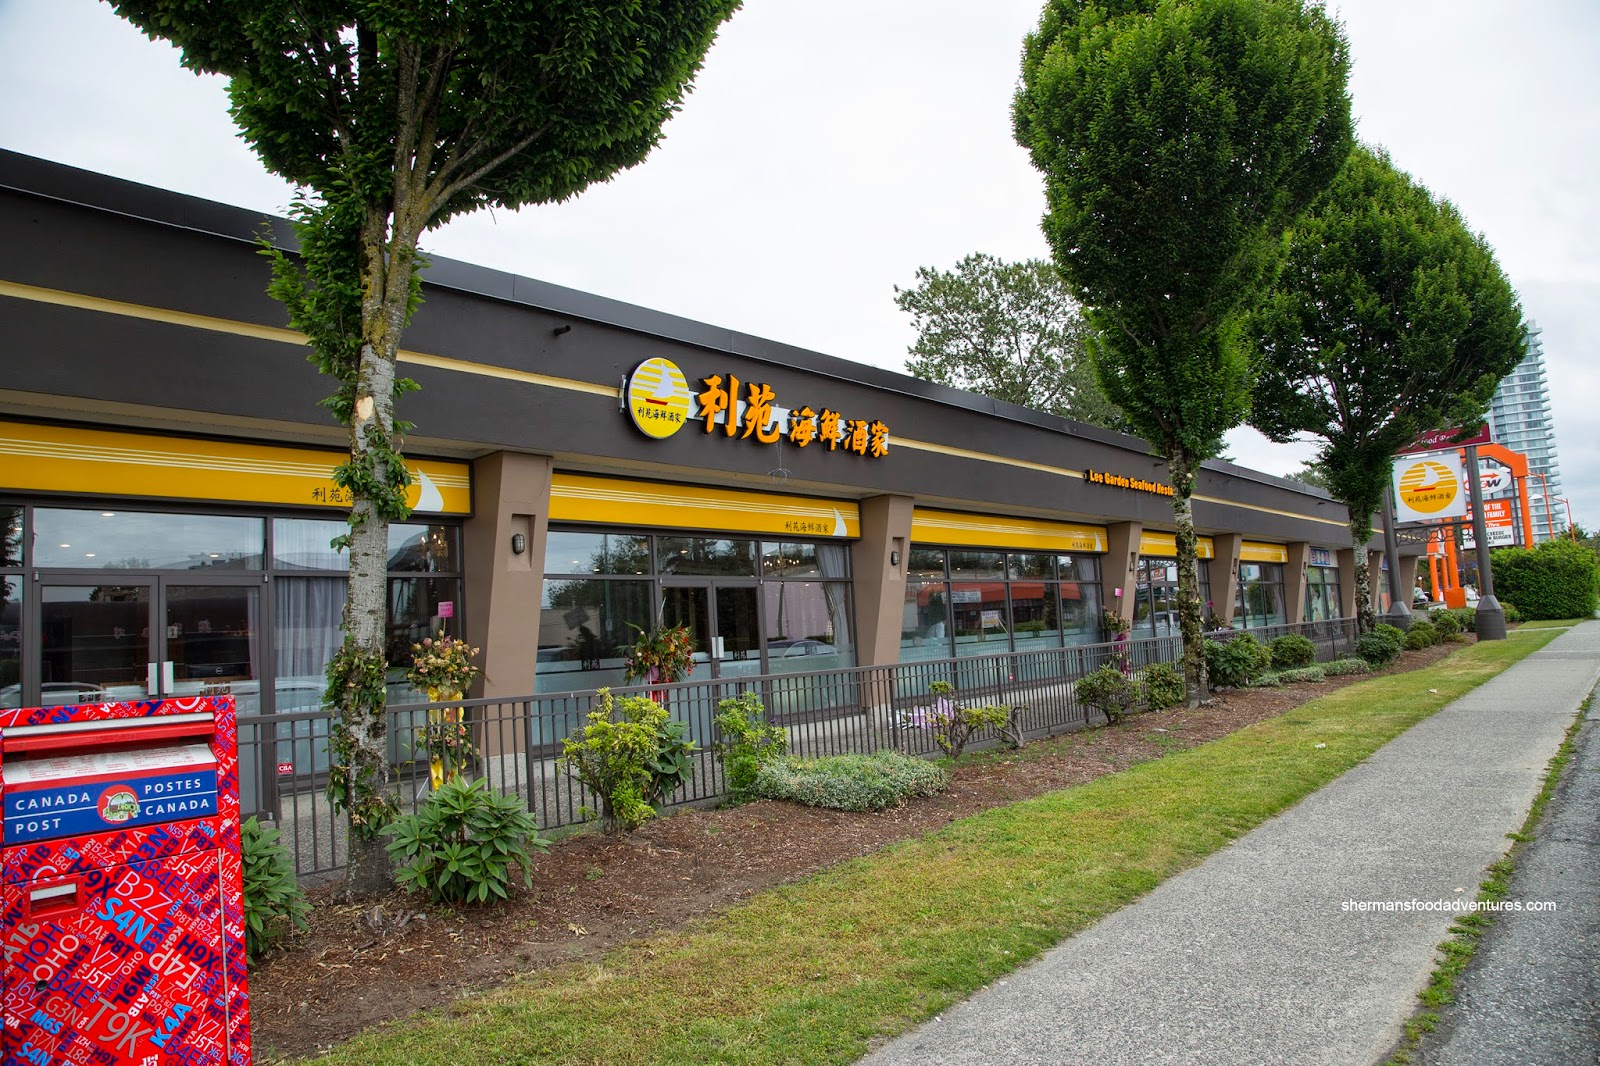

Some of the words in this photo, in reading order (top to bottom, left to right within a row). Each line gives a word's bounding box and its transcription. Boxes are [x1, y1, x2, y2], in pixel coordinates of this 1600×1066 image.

[1089, 469, 1104, 483] Lee
[1104, 472, 1130, 488] Garden
[1129, 477, 1156, 493] Seafood
[1487, 510, 1505, 518] FAMILY
[145, 778, 201, 794] POSTES
[15, 792, 91, 810] CANADA
[146, 798, 210, 816] CANADA
[15, 818, 62, 834] POST
[116, 831, 147, 860] X1A
[21, 845, 51, 876] A1B
[172, 860, 198, 879] J5T
[115, 871, 173, 921] B2Z
[73, 913, 103, 940] X1A
[96, 897, 154, 944] S4N
[102, 932, 135, 959] P8T
[141, 917, 175, 954] B3N
[176, 934, 220, 972] H9X
[82, 967, 112, 988] J5T
[149, 948, 201, 990] E4P
[48, 969, 95, 1008] B4E
[182, 986, 209, 1012] X1A
[46, 996, 83, 1025] G3N
[128, 992, 149, 1017] A1B
[146, 999, 168, 1019] P9A
[30, 1009, 64, 1034] M6S
[85, 997, 153, 1059] T9K
[149, 1003, 192, 1048] K4A
[15, 1041, 53, 1066] S4N
[28, 1028, 62, 1054] R7N
[191, 1034, 214, 1051] J5T
